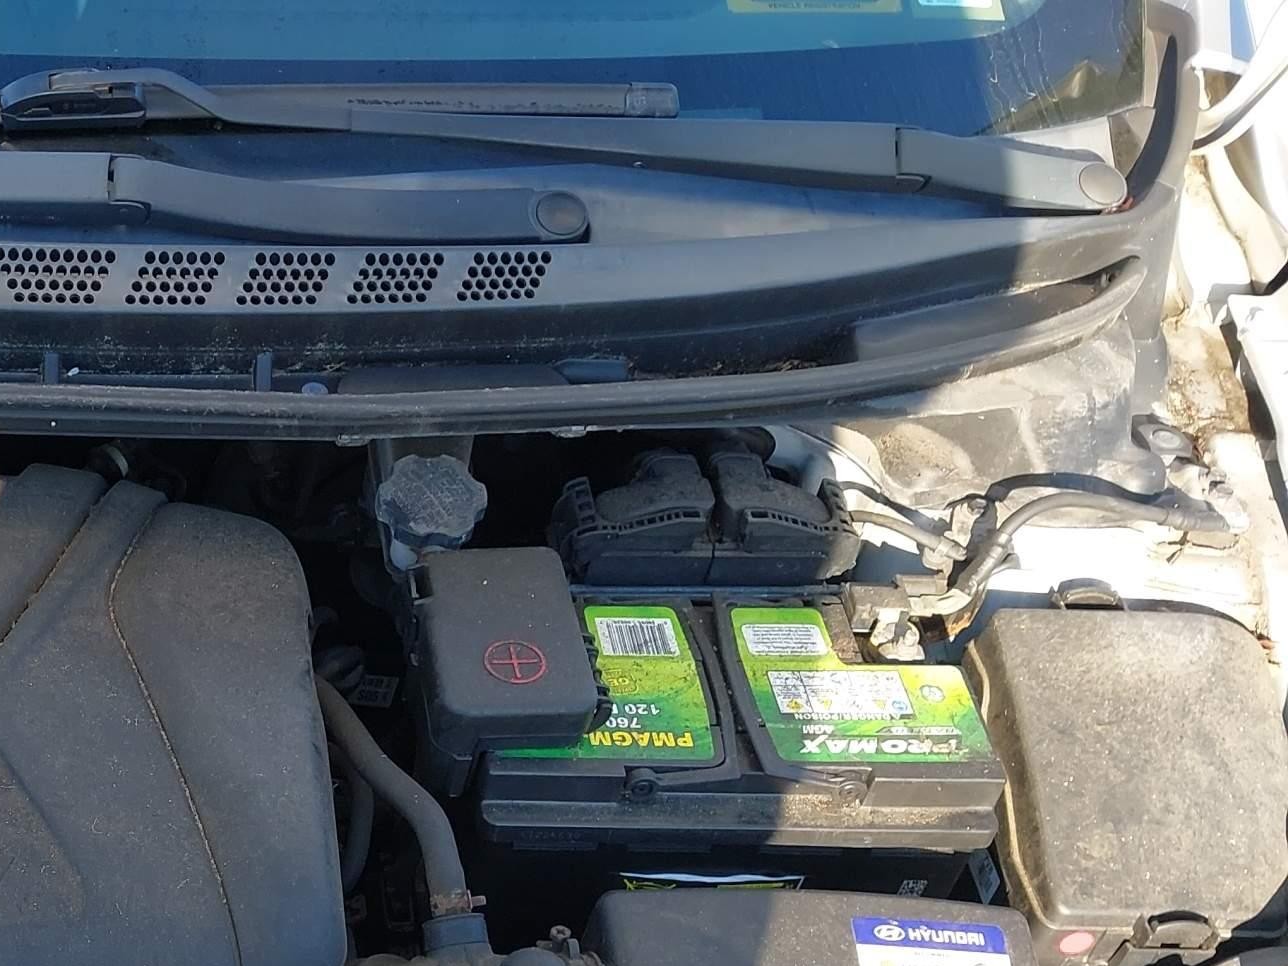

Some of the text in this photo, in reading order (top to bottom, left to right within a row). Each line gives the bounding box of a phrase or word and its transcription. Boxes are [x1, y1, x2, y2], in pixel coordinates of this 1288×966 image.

[624, 703, 661, 715] 120
[604, 717, 642, 729] 760
[802, 724, 835, 734] AGM
[907, 928, 986, 946] HYUNDAI
